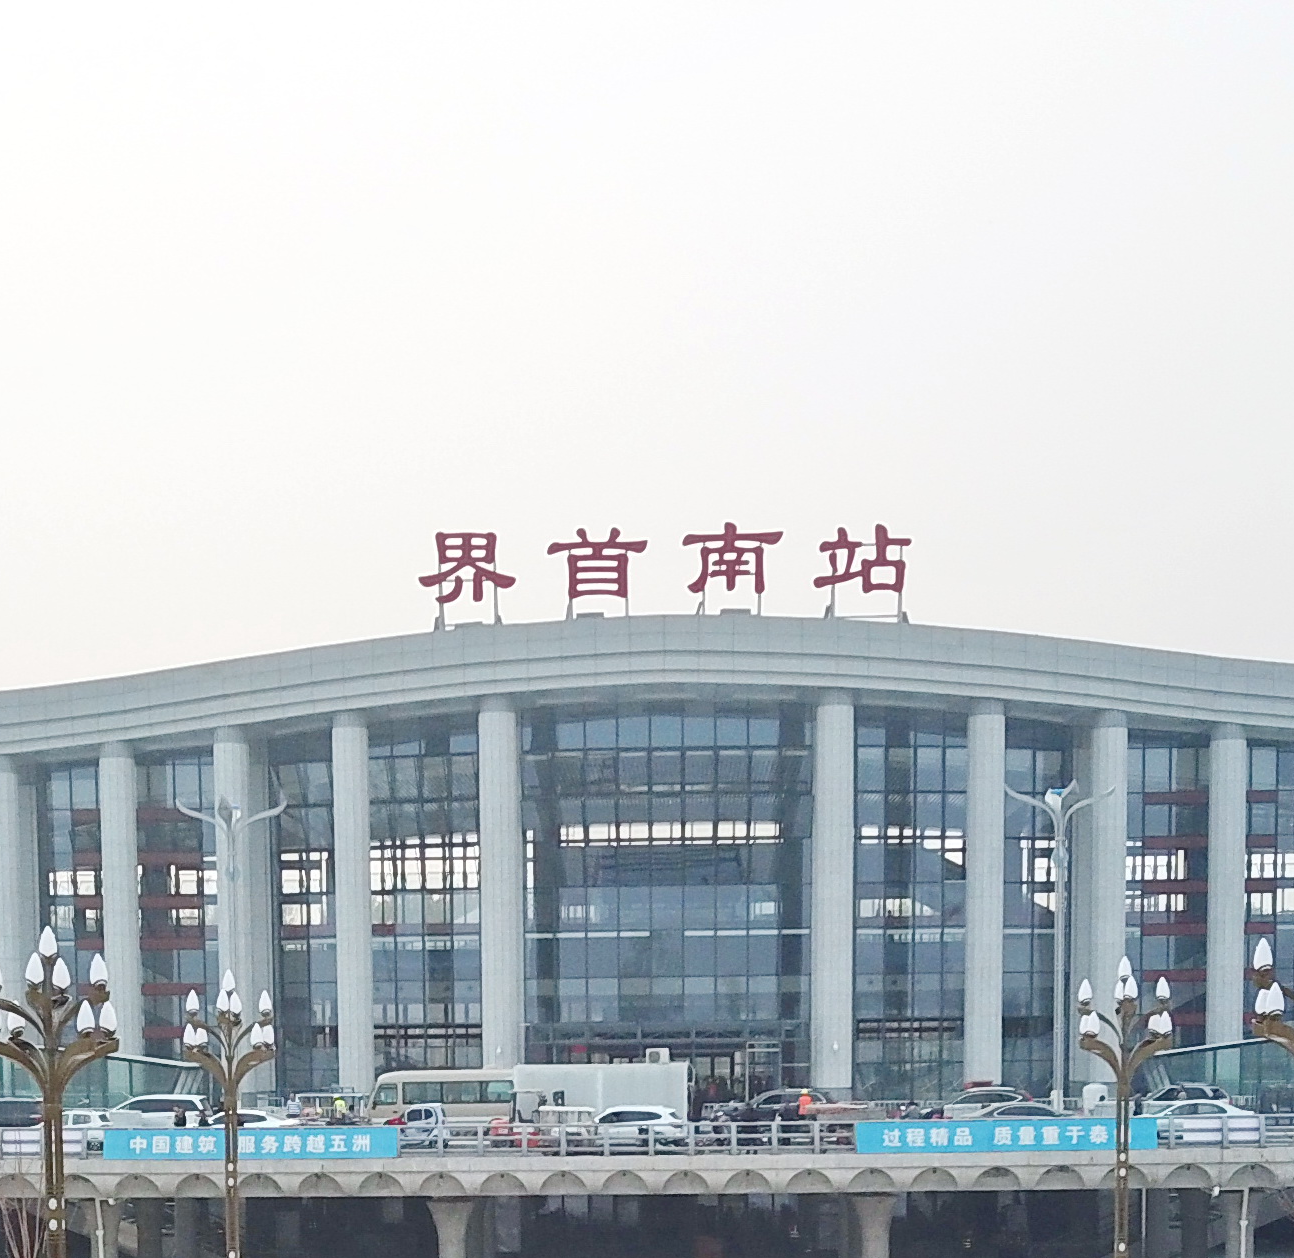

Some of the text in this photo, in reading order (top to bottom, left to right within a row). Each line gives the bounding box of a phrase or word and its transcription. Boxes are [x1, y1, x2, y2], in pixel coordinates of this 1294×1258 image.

[419, 522, 912, 603] 界首南站
[129, 1134, 371, 1154] 中国建筑 服务跨越五洲
[882, 1128, 973, 1147] 过程精品
